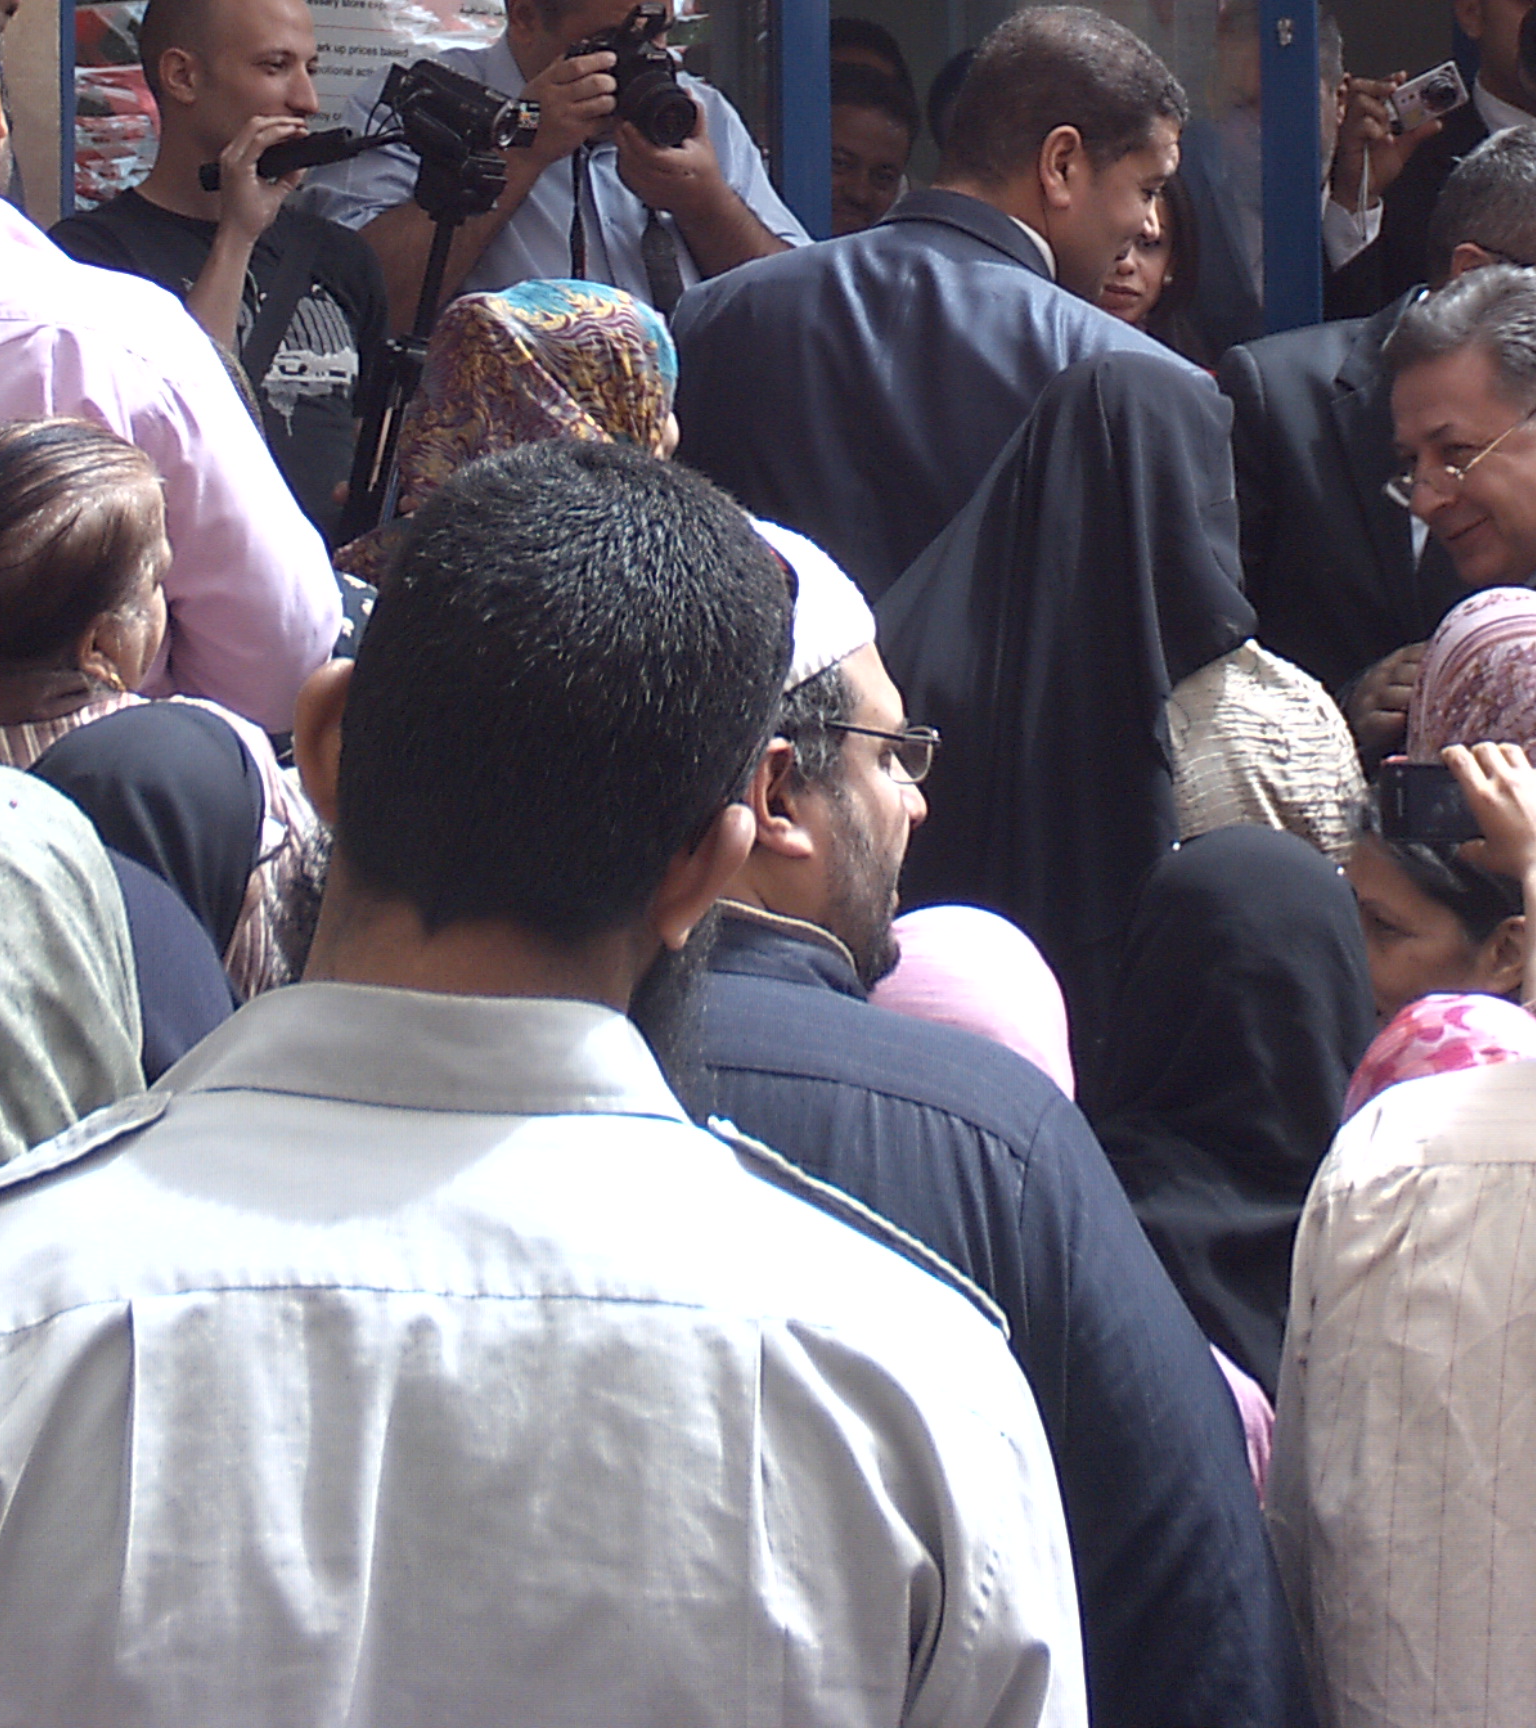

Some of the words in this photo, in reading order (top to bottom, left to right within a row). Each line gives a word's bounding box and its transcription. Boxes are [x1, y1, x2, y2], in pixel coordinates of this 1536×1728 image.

[317, 43, 331, 52] ark
[334, 46, 347, 55] up
[348, 45, 378, 57] prices
[380, 46, 409, 57] based
